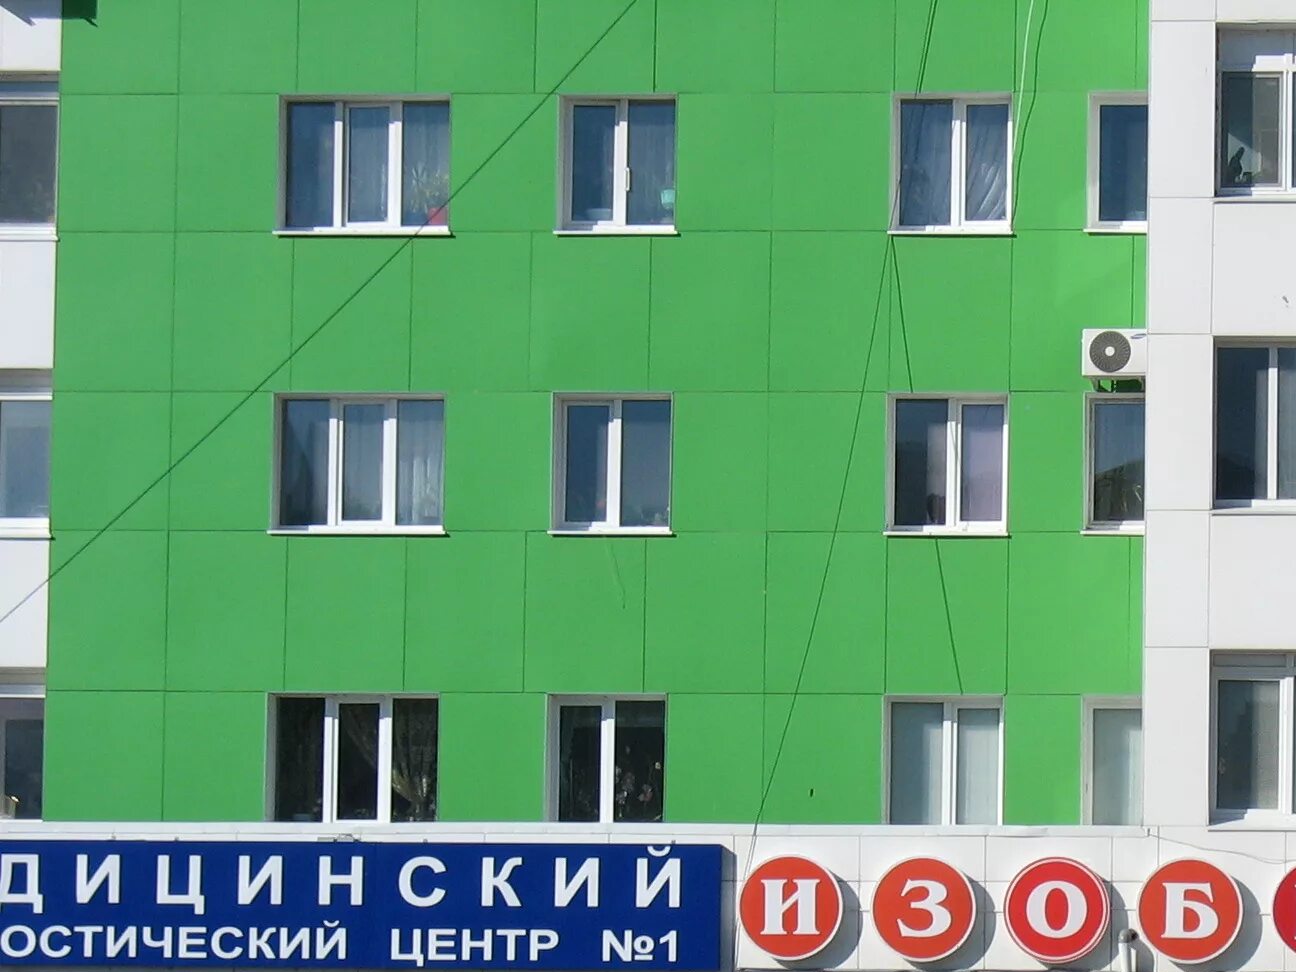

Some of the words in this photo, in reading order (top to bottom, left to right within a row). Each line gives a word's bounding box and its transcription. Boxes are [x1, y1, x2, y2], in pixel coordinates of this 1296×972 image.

[0, 846, 681, 914] ДИЦИНСКИЙ
[0, 920, 347, 960] ОСТИЧЕСКИЙ
[390, 928, 560, 967] ЦЕНТР
[602, 929, 678, 962] №1
